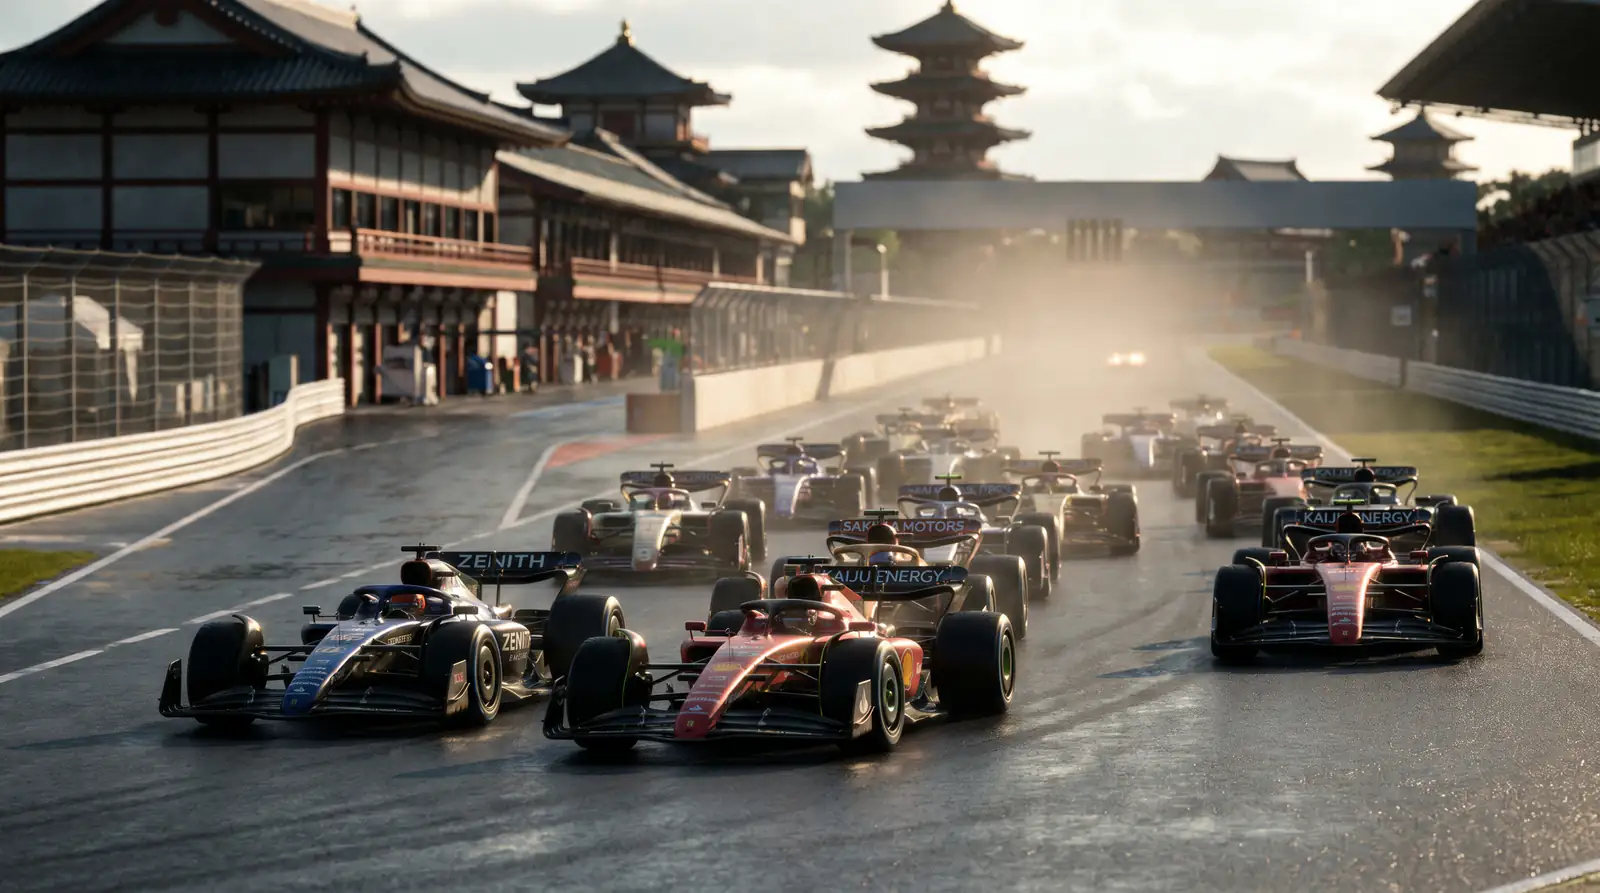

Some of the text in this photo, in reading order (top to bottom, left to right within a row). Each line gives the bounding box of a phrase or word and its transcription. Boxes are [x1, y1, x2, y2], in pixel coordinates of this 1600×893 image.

[1304, 511, 1412, 524] KAIJ NERGY
[843, 520, 965, 532] SAKA MOTORS
[457, 554, 545, 568] ZENITH
[876, 569, 944, 583] ENERGY
